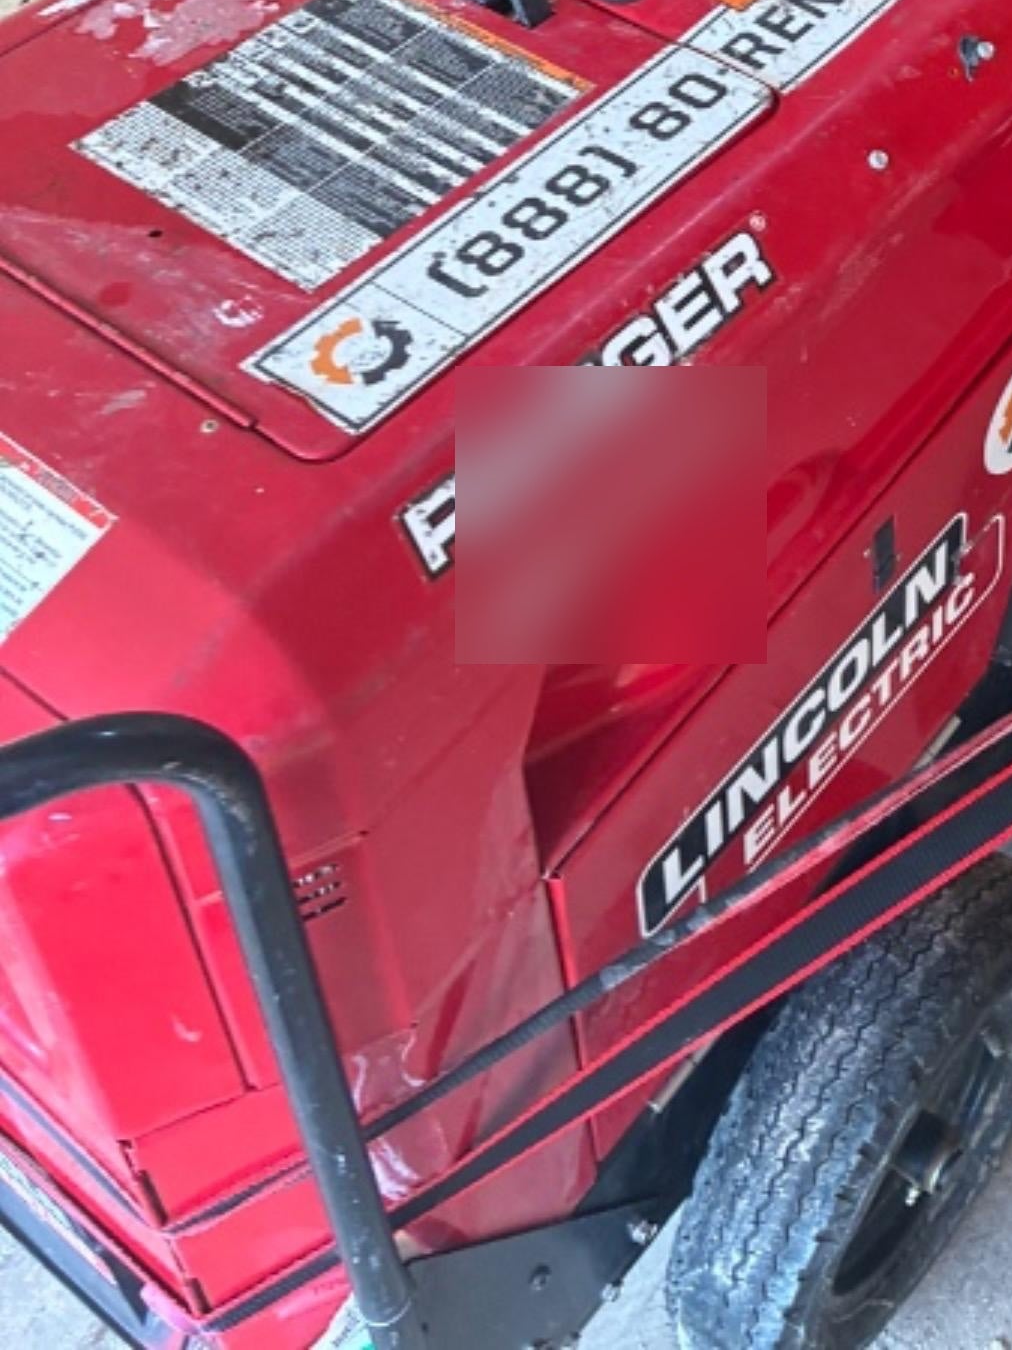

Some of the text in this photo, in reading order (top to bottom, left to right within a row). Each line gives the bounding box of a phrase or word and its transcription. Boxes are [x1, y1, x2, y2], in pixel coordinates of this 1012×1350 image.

[426, 145, 637, 300] (888)
[662, 540, 950, 905] LINCOLN
[742, 572, 976, 865] ELECTRIC
